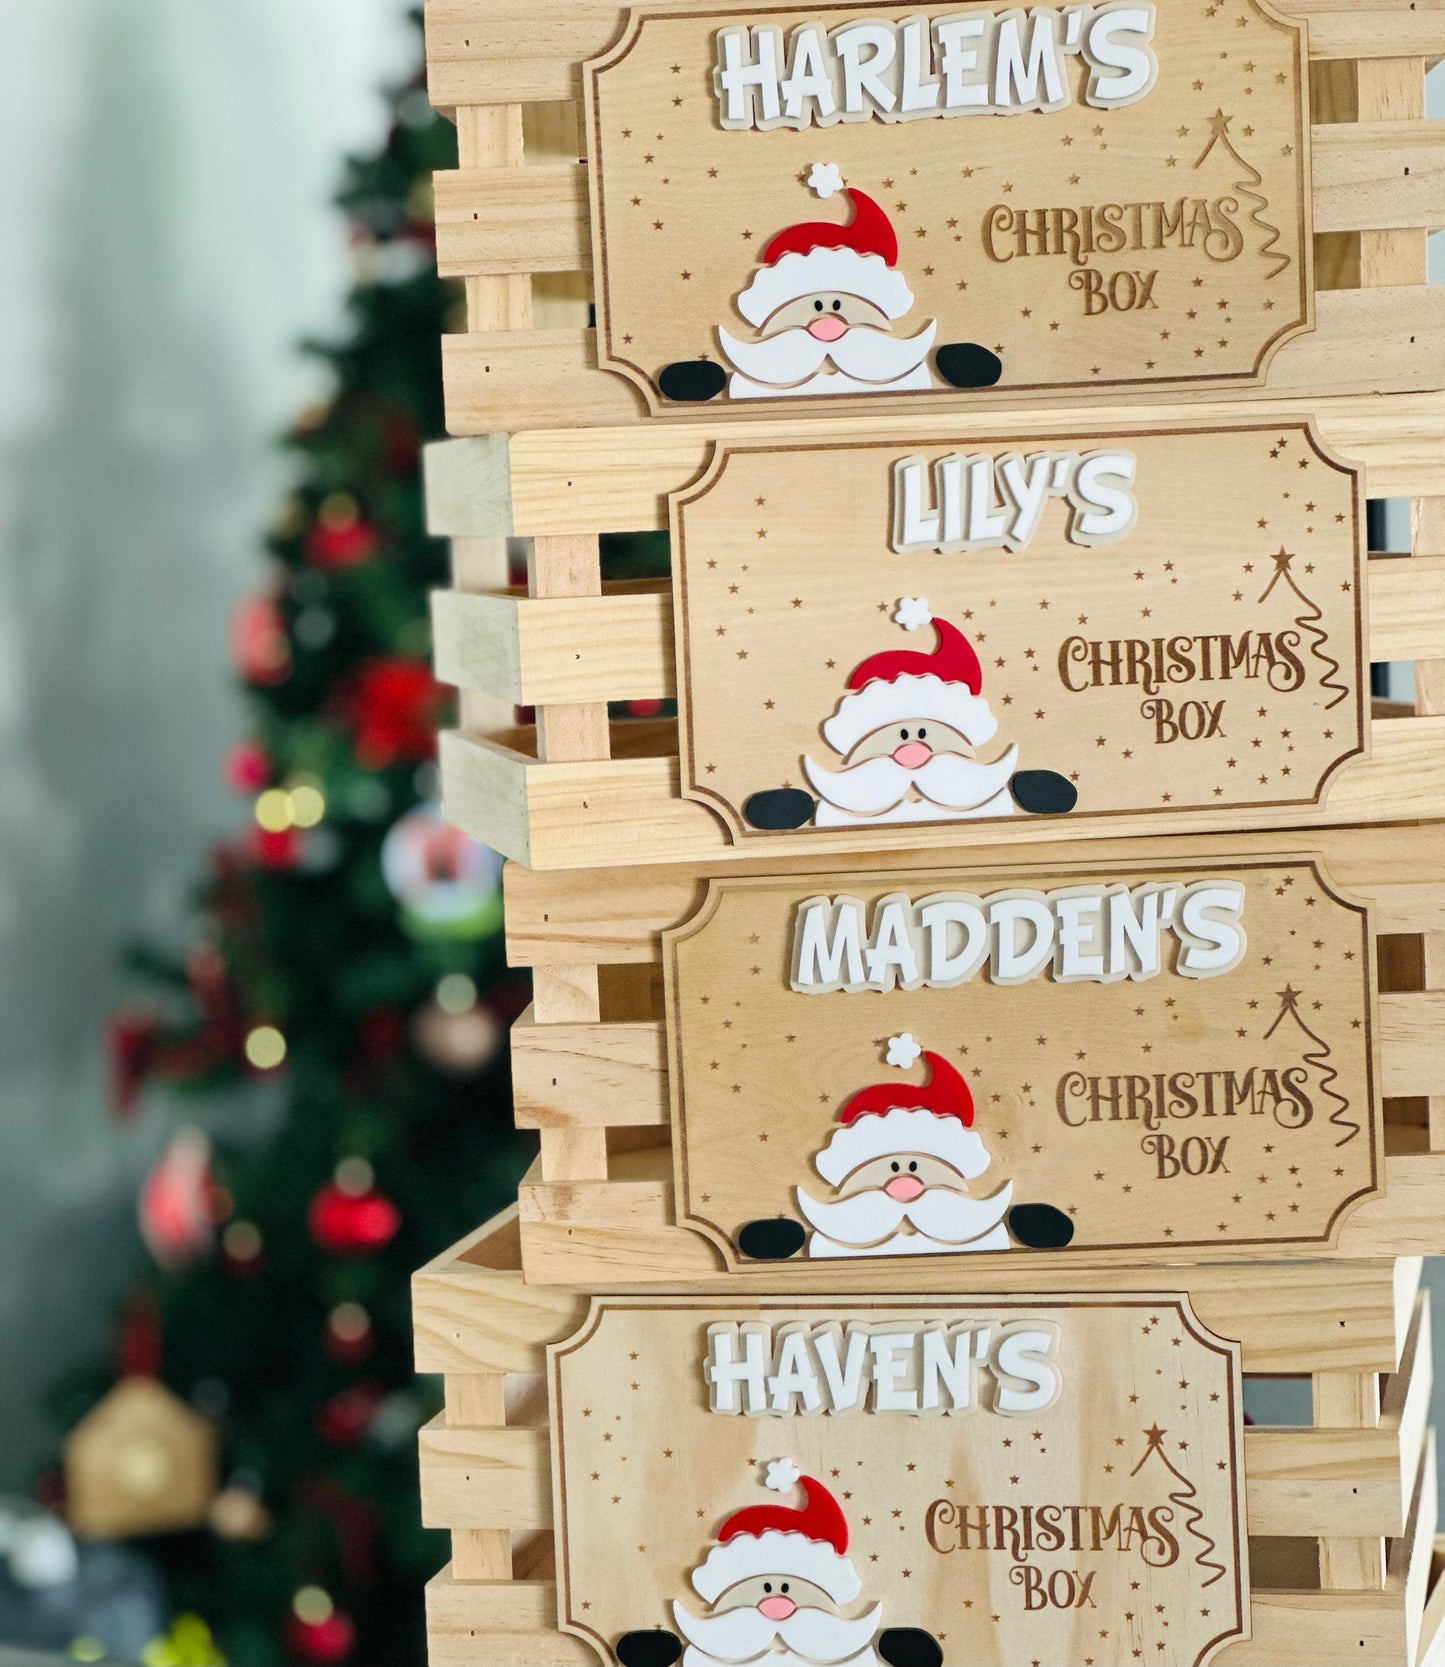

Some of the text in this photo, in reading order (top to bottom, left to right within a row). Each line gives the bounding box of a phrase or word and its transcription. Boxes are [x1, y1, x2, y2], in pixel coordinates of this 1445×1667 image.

[719, 5, 1156, 122] HARLEM'S
[982, 196, 1244, 265] CHRISTMAS
[1068, 268, 1159, 316] BOX
[900, 453, 1136, 546] LILY'S
[1058, 630, 1306, 694] CHRISTMAS
[1140, 698, 1228, 745] BOX
[798, 888, 1243, 986] MADDEN'S
[1055, 1067, 1314, 1130] CHRISTMAS
[1141, 1134, 1232, 1180] BOX
[709, 1328, 1058, 1412] HAVEN'S
[924, 1499, 1180, 1567] CHRISTMAS
[1009, 1569, 1098, 1611] BOX
